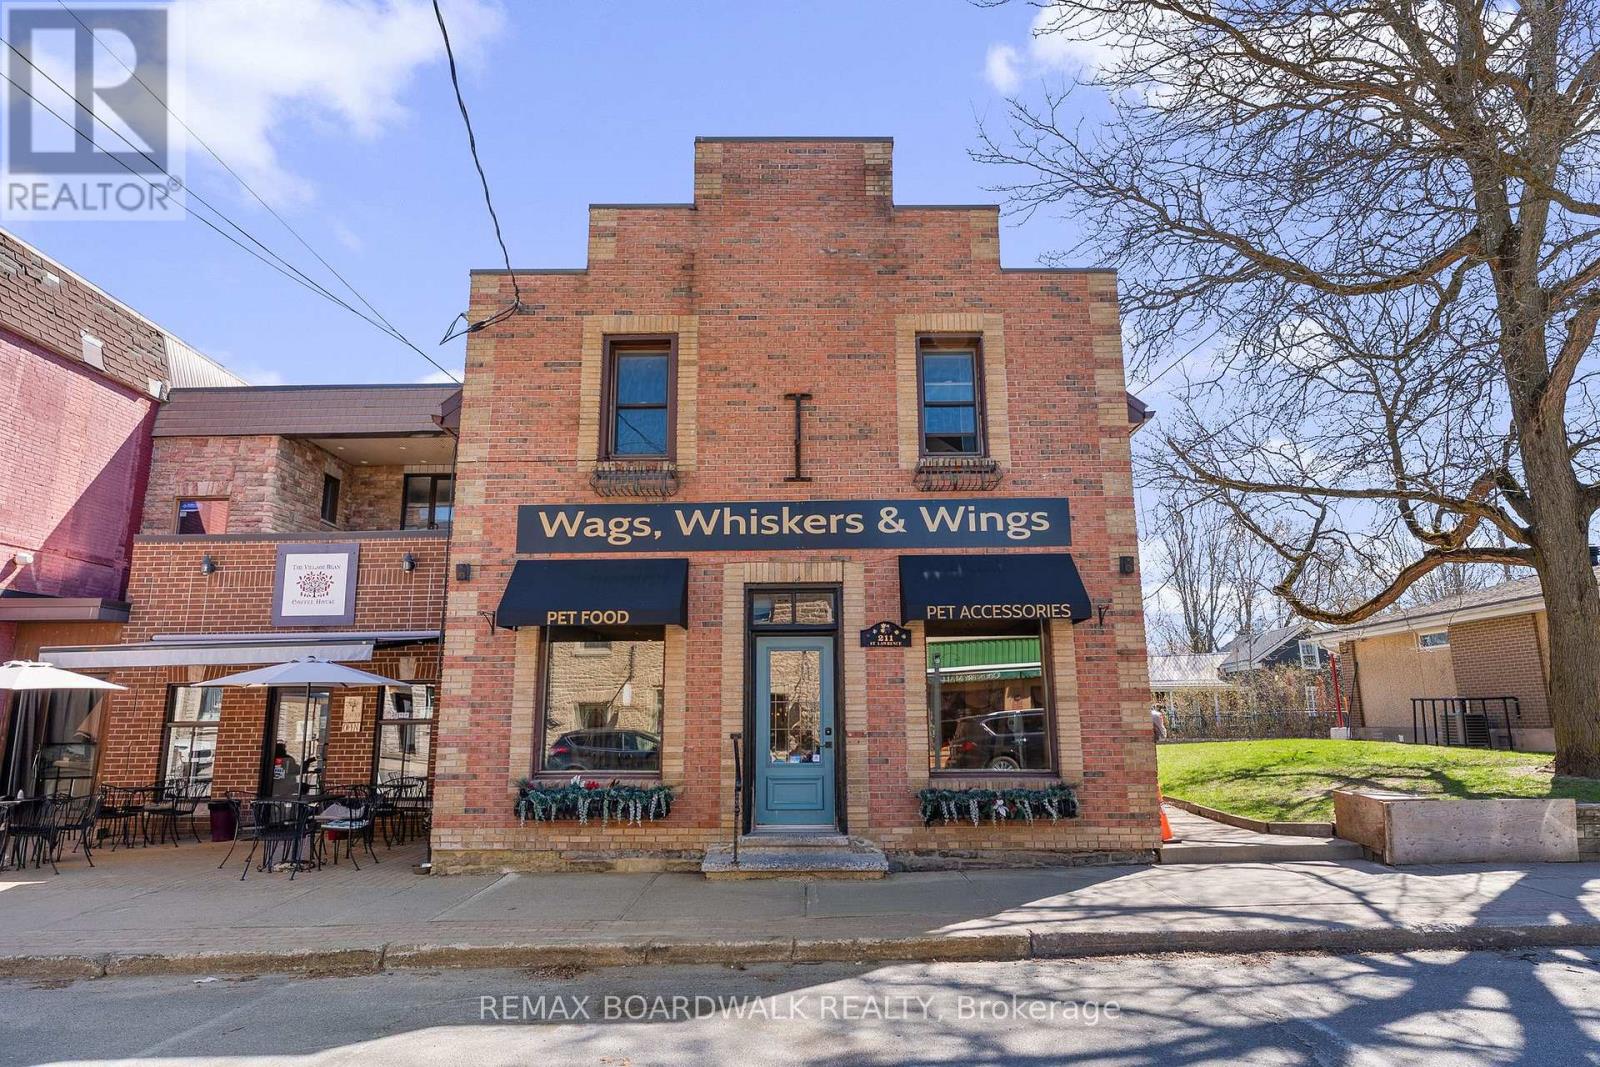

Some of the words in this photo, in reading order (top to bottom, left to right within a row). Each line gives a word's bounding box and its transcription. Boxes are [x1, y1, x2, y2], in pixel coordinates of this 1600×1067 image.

[538, 510, 662, 546] Wags,
[674, 506, 865, 537] Whiskers
[877, 506, 908, 535] &
[919, 505, 1050, 540] Wings
[547, 610, 578, 625] PET
[580, 610, 630, 625] FOOD
[926, 605, 956, 620] PET
[960, 603, 1072, 619] ACCESSORIES
